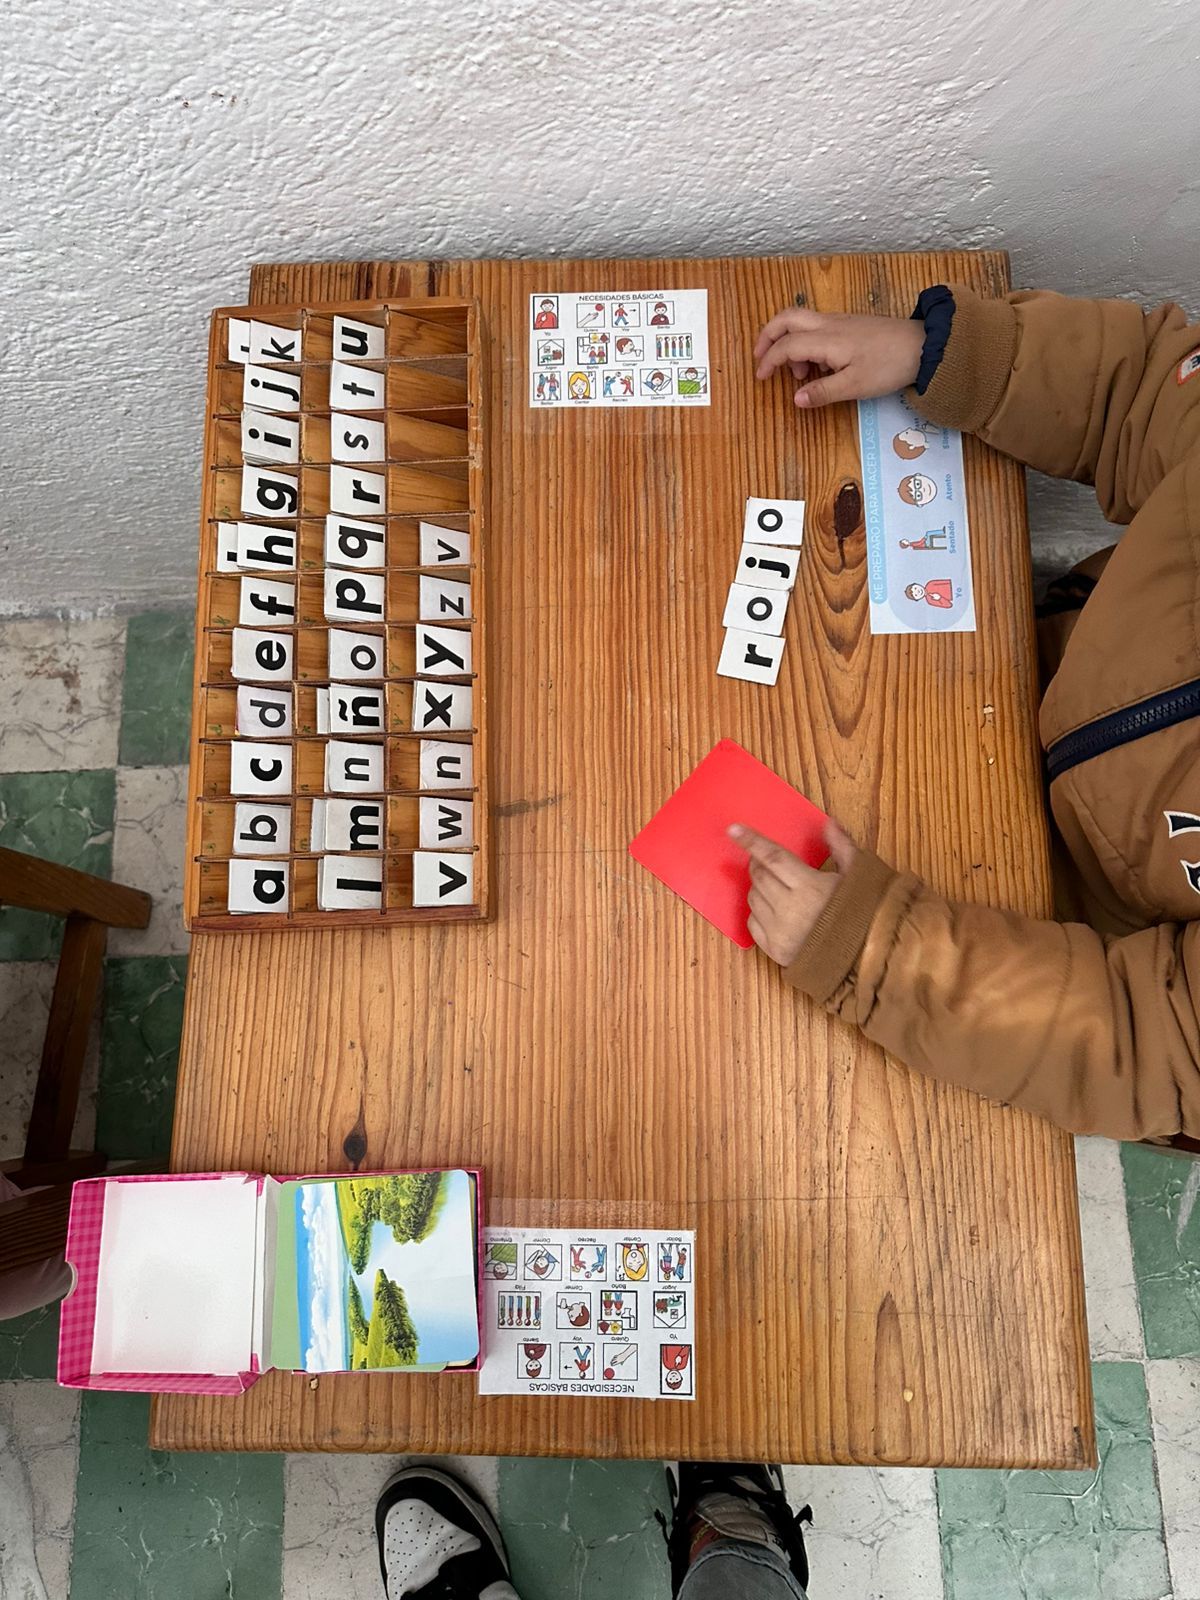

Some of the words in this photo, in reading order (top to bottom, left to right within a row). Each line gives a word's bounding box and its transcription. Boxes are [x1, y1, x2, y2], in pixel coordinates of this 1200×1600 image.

[578, 294, 631, 302] NECESIDADES
[632, 293, 665, 301] BÁSICAS
[261, 337, 295, 361] k
[341, 326, 368, 356] u
[250, 378, 299, 402] j
[343, 383, 374, 396] t
[249, 429, 291, 448] i
[344, 431, 368, 449] s
[865, 429, 876, 451] LAS
[866, 453, 878, 490] HACER
[256, 477, 297, 514] g
[353, 480, 380, 504] r
[945, 473, 953, 501] Atento
[869, 493, 880, 523] PARA
[246, 535, 294, 565] h
[338, 525, 384, 558] q
[438, 539, 460, 561] v
[948, 520, 956, 554] Sentado
[870, 526, 883, 580] PREPARO
[250, 593, 295, 616] f
[335, 578, 382, 614] p
[441, 594, 464, 616] z
[872, 584, 883, 600] ME
[955, 587, 962, 598] Yo
[256, 641, 286, 670] e
[351, 645, 376, 670] o
[423, 633, 464, 670] y
[250, 700, 286, 728] d
[339, 697, 380, 726] ñ
[423, 688, 453, 728] x
[250, 759, 282, 781] c
[345, 758, 369, 781] n
[437, 756, 460, 779] n
[240, 815, 277, 842] b
[349, 805, 379, 850] m
[439, 805, 461, 841] w
[253, 870, 285, 904] a
[439, 861, 467, 897] v
[529, 1383, 568, 1393] BÁSICAS
[571, 1383, 635, 1393] NECESIDADES
